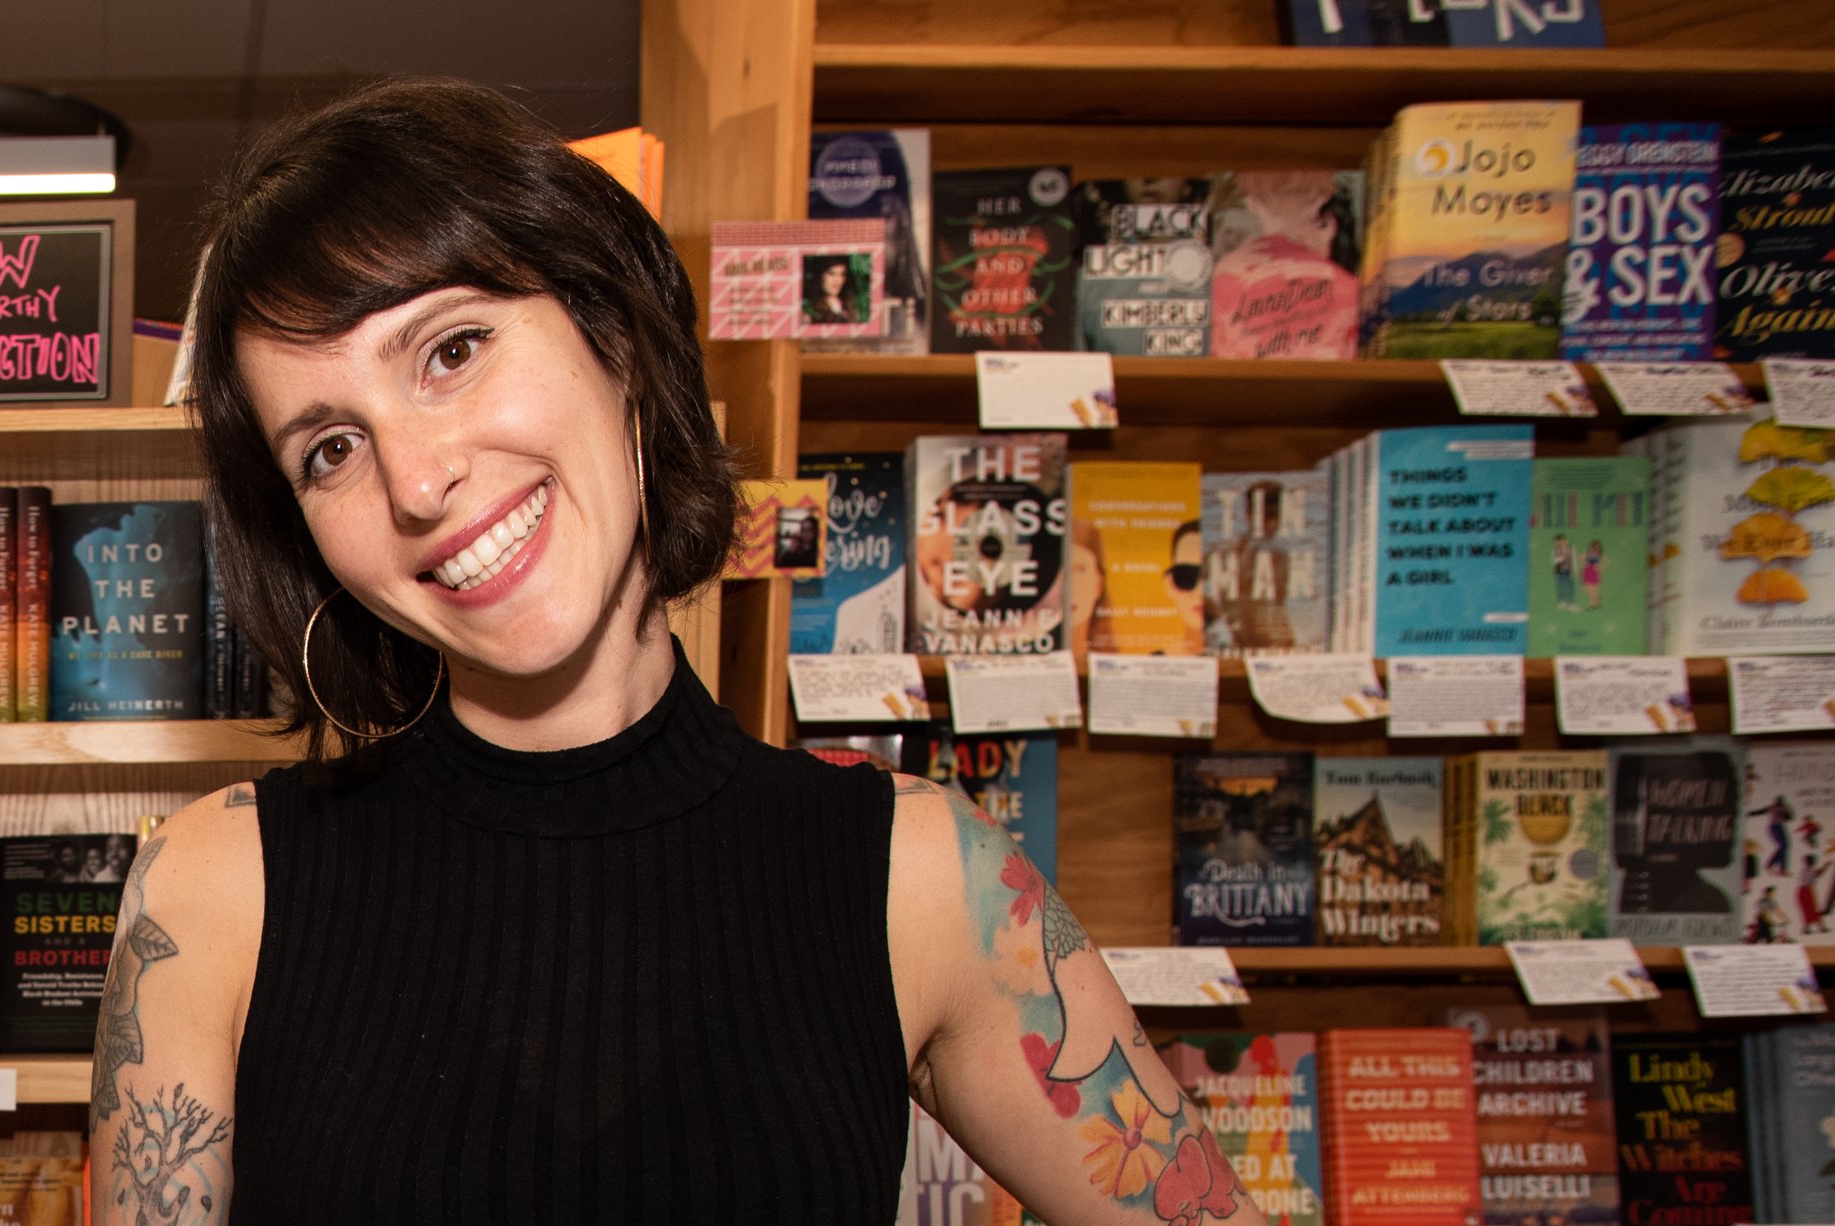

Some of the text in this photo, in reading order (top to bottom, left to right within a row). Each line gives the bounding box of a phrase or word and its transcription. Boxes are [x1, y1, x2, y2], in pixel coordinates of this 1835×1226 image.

[1455, 139, 1535, 178] Jojo
[978, 199, 1022, 214] HER
[1432, 183, 1552, 221] Moyes
[1114, 205, 1205, 238] BLACK
[1571, 184, 1711, 246] BOYS
[969, 227, 1030, 247] BODY
[974, 257, 1026, 275] AND
[962, 285, 1038, 306] OTHER
[1563, 245, 1713, 324] & SEX
[955, 316, 1044, 337] PARTIES
[944, 447, 1042, 482] THE
[1388, 469, 1467, 484] THINGS
[1389, 494, 1422, 509] WE
[916, 500, 1066, 536] GLASS
[1388, 517, 1516, 535] TALK ABOUT
[87, 543, 163, 563] INTO
[1387, 544, 1514, 561] WHEN WAS
[95, 579, 156, 598] THE
[943, 561, 1040, 596] EYE
[1407, 570, 1455, 585] GIRL
[28, 604, 40, 638] KATE
[62, 614, 190, 635] PLANET
[924, 633, 1055, 654] VANASCO
[929, 739, 1027, 779] LADY
[1485, 768, 1606, 790] WASHINGTON
[1319, 848, 1365, 874] The
[1320, 876, 1431, 903] Dakota
[1184, 882, 1311, 926] BRITTANY
[14, 915, 117, 934] SISTERS
[1321, 908, 1441, 943] Winters
[1496, 1028, 1559, 1053] LOST
[1349, 1056, 1461, 1077] ALL THIS
[1473, 1060, 1594, 1084] CHILDREN
[1629, 1053, 1715, 1083] Lindy
[1195, 1075, 1306, 1098] JACQUELINE
[1346, 1089, 1465, 1110] COULD BE
[1478, 1092, 1588, 1116] ARCHIVE
[1662, 1086, 1737, 1114] West
[1202, 1107, 1312, 1132] WOODSON
[1636, 1111, 1701, 1140] The
[1365, 1122, 1452, 1142] YOURS
[1269, 1154, 1299, 1180] AT
[1482, 1143, 1586, 1167] VALERIA
[1621, 1144, 1743, 1171] Witches
[1481, 1176, 1592, 1198] LUISELLI
